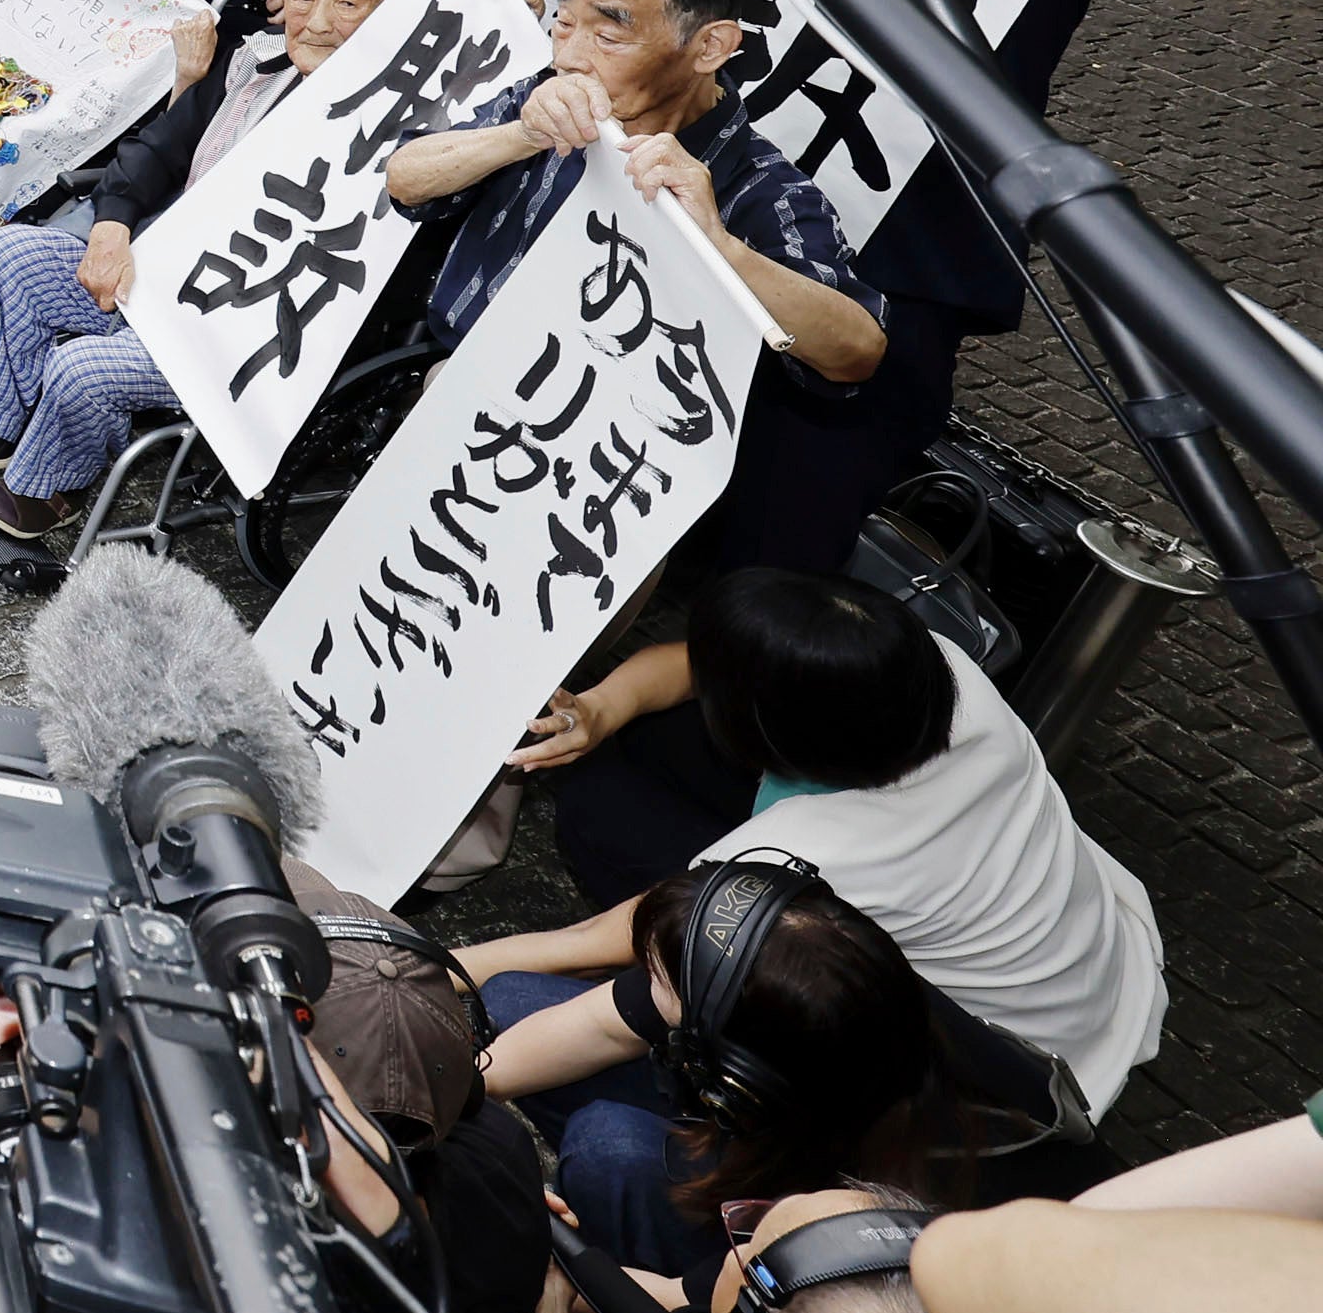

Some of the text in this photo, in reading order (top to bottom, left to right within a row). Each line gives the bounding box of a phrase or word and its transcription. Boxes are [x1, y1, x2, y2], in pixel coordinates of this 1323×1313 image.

[537, 319, 736, 633] 今まで
[705, 875, 773, 957] AKG
